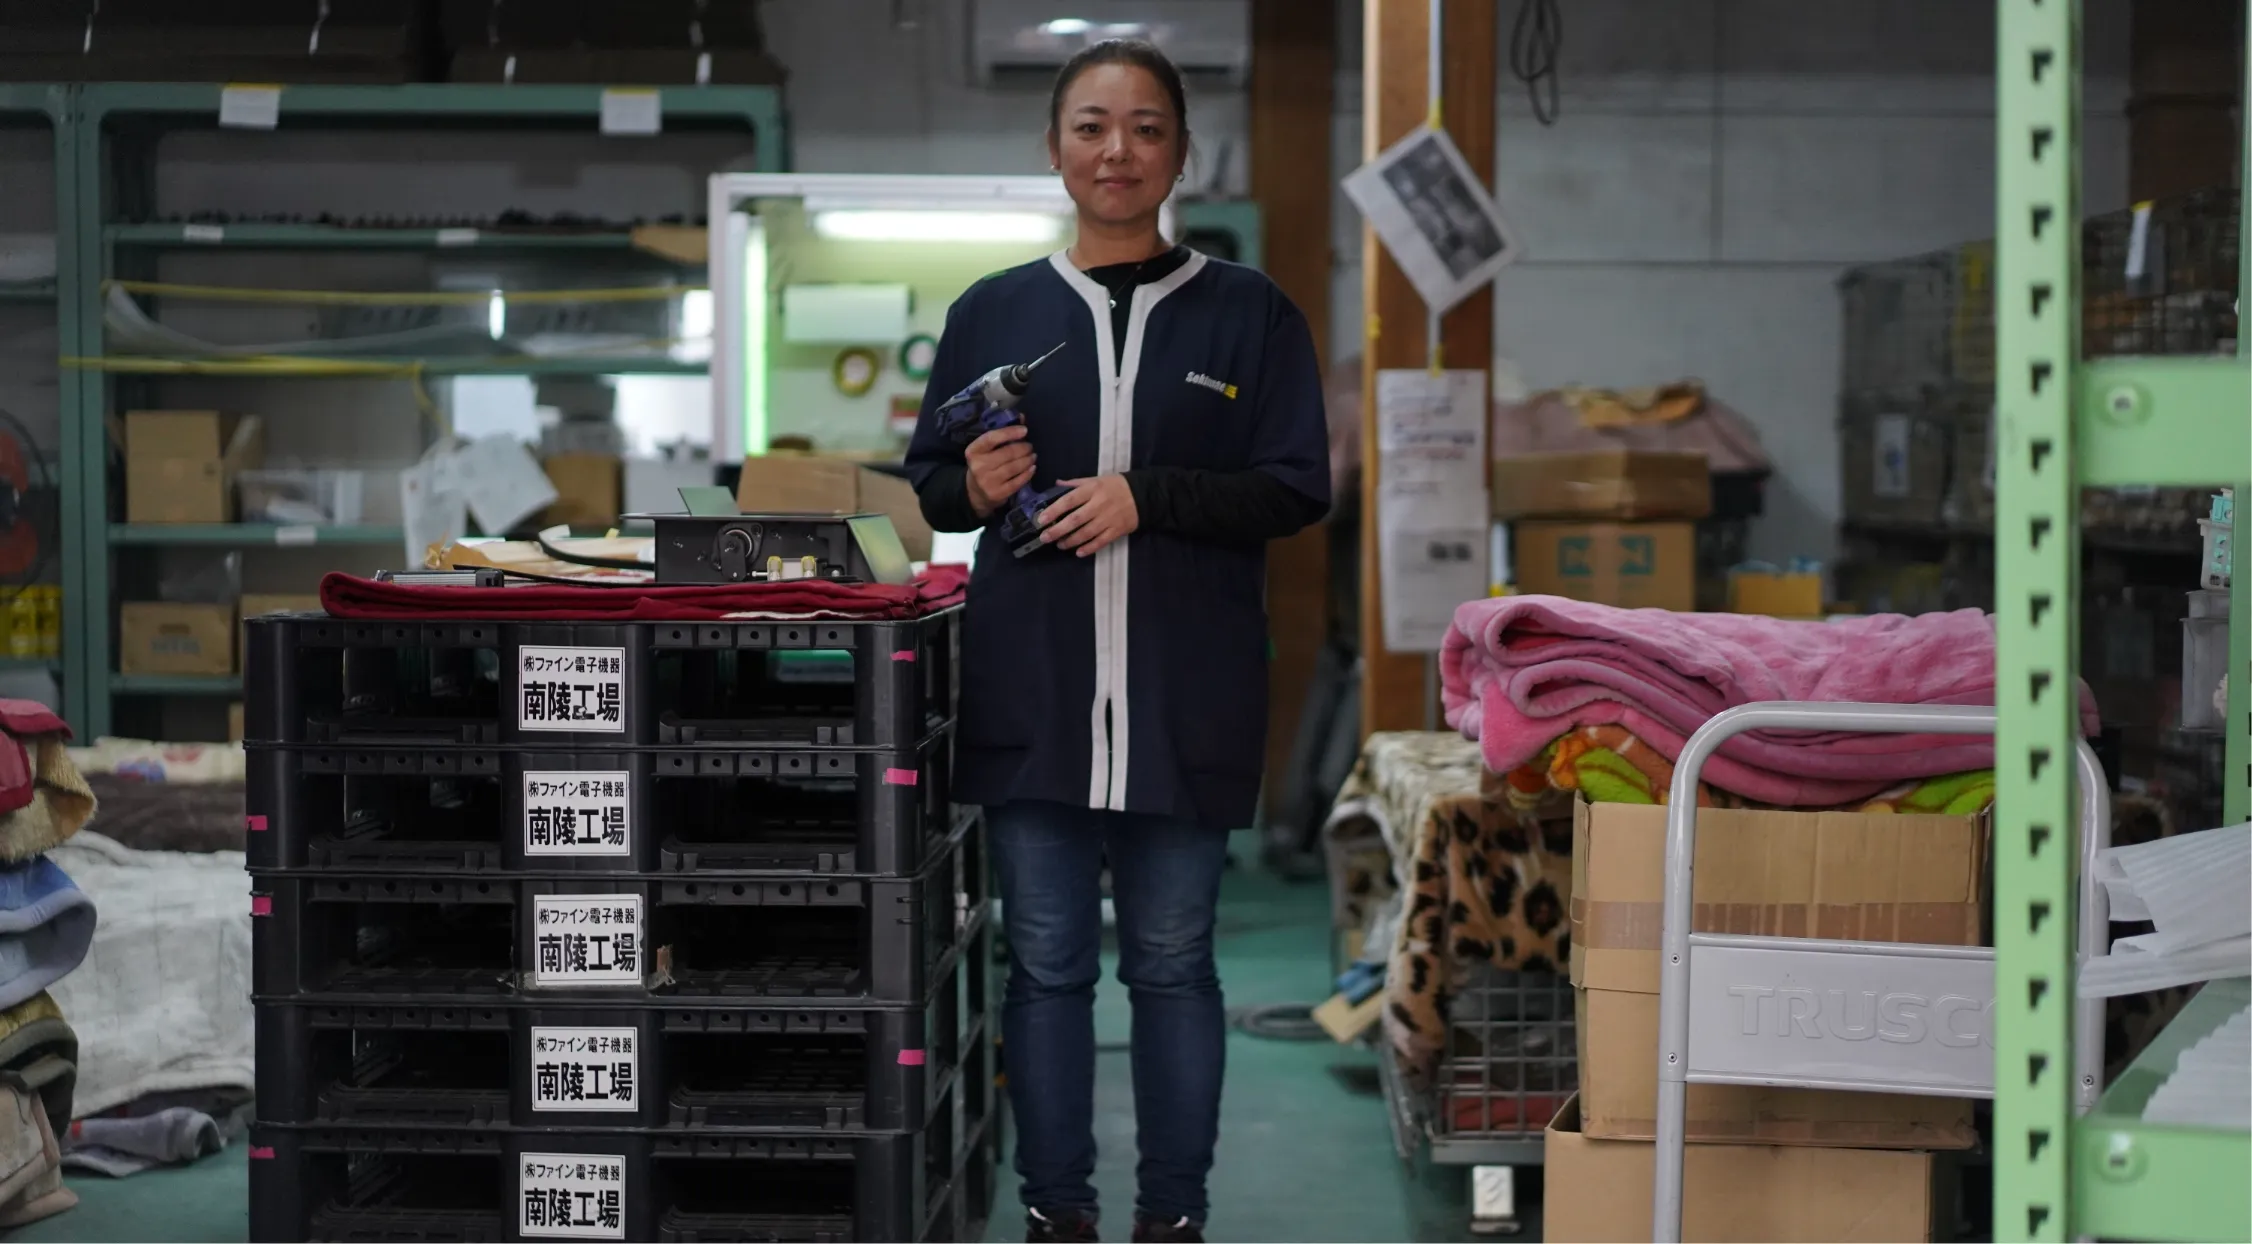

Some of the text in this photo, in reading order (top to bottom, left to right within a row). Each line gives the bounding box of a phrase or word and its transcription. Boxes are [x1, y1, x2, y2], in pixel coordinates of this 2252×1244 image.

[523, 681, 621, 722] 南陵工場
[528, 806, 626, 846] 南陵工場
[539, 933, 637, 973] 南陵工場
[536, 1061, 633, 1102] 南陵工場
[524, 1187, 621, 1229] 南陵工場
